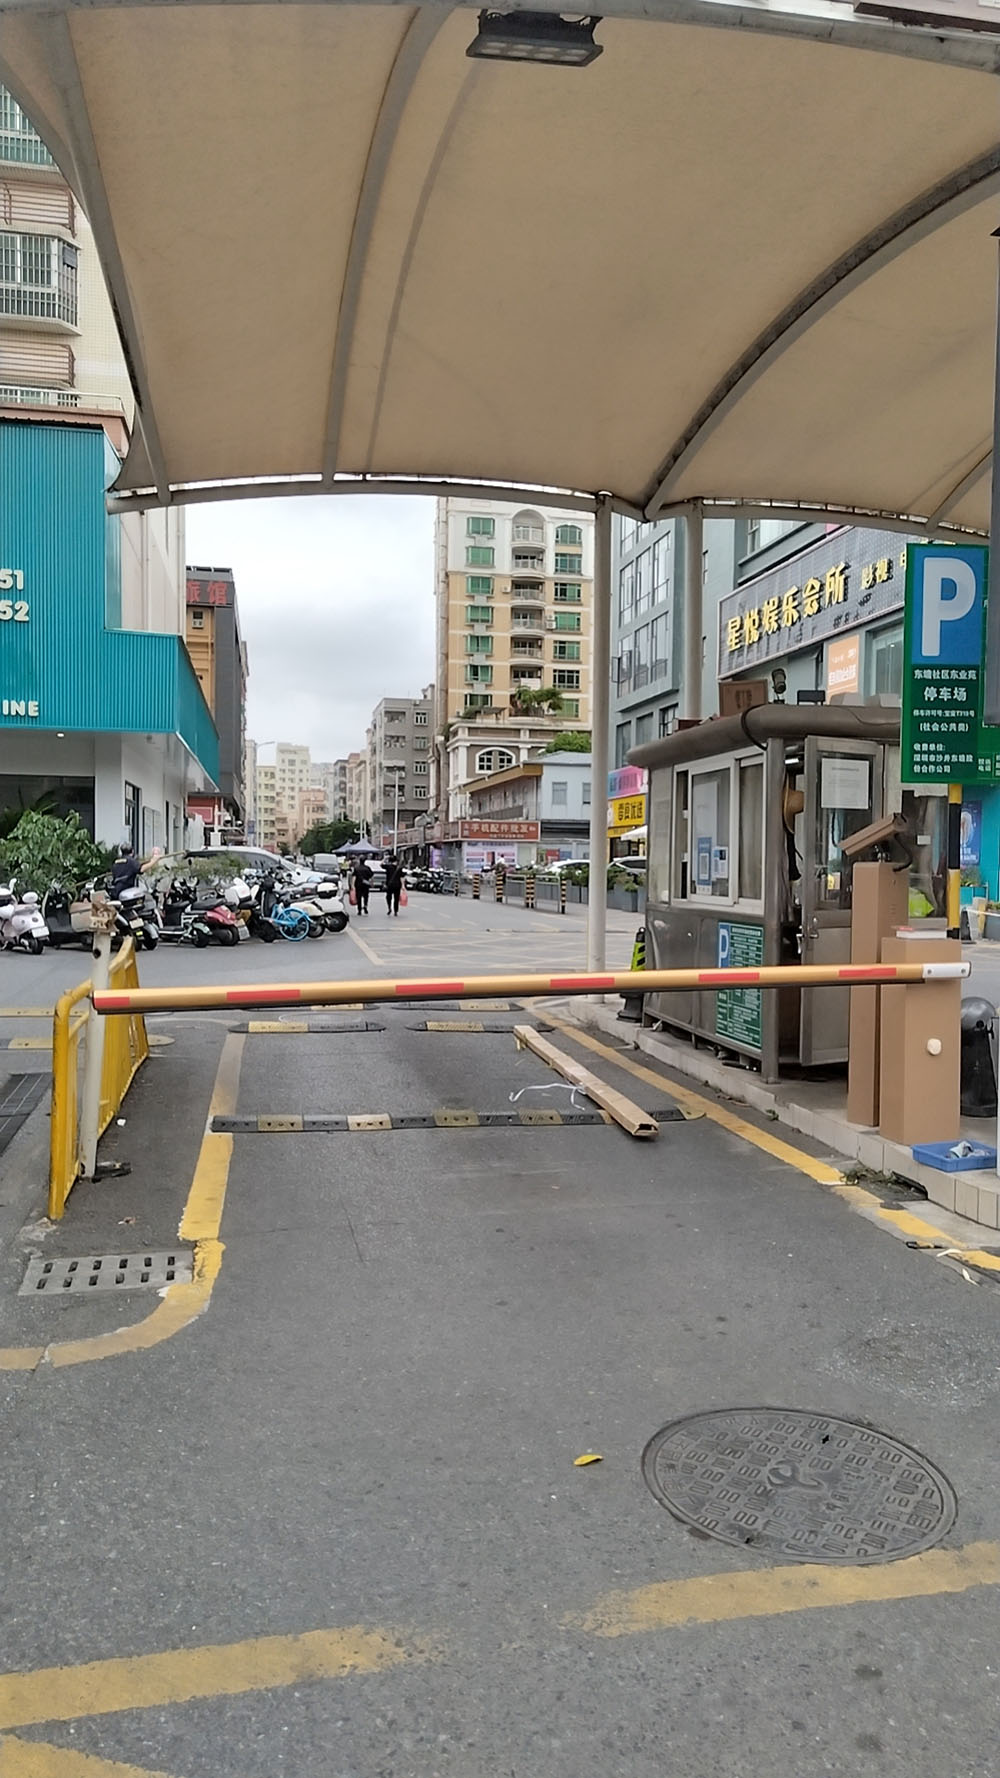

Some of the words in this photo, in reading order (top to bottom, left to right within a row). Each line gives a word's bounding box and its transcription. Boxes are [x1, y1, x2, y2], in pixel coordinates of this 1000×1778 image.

[0, 569, 24, 590] 51
[0, 600, 30, 622] 52
[727, 561, 846, 652] 星悦娱乐会所
[921, 557, 976, 656] P
[924, 686, 967, 701] 停车场
